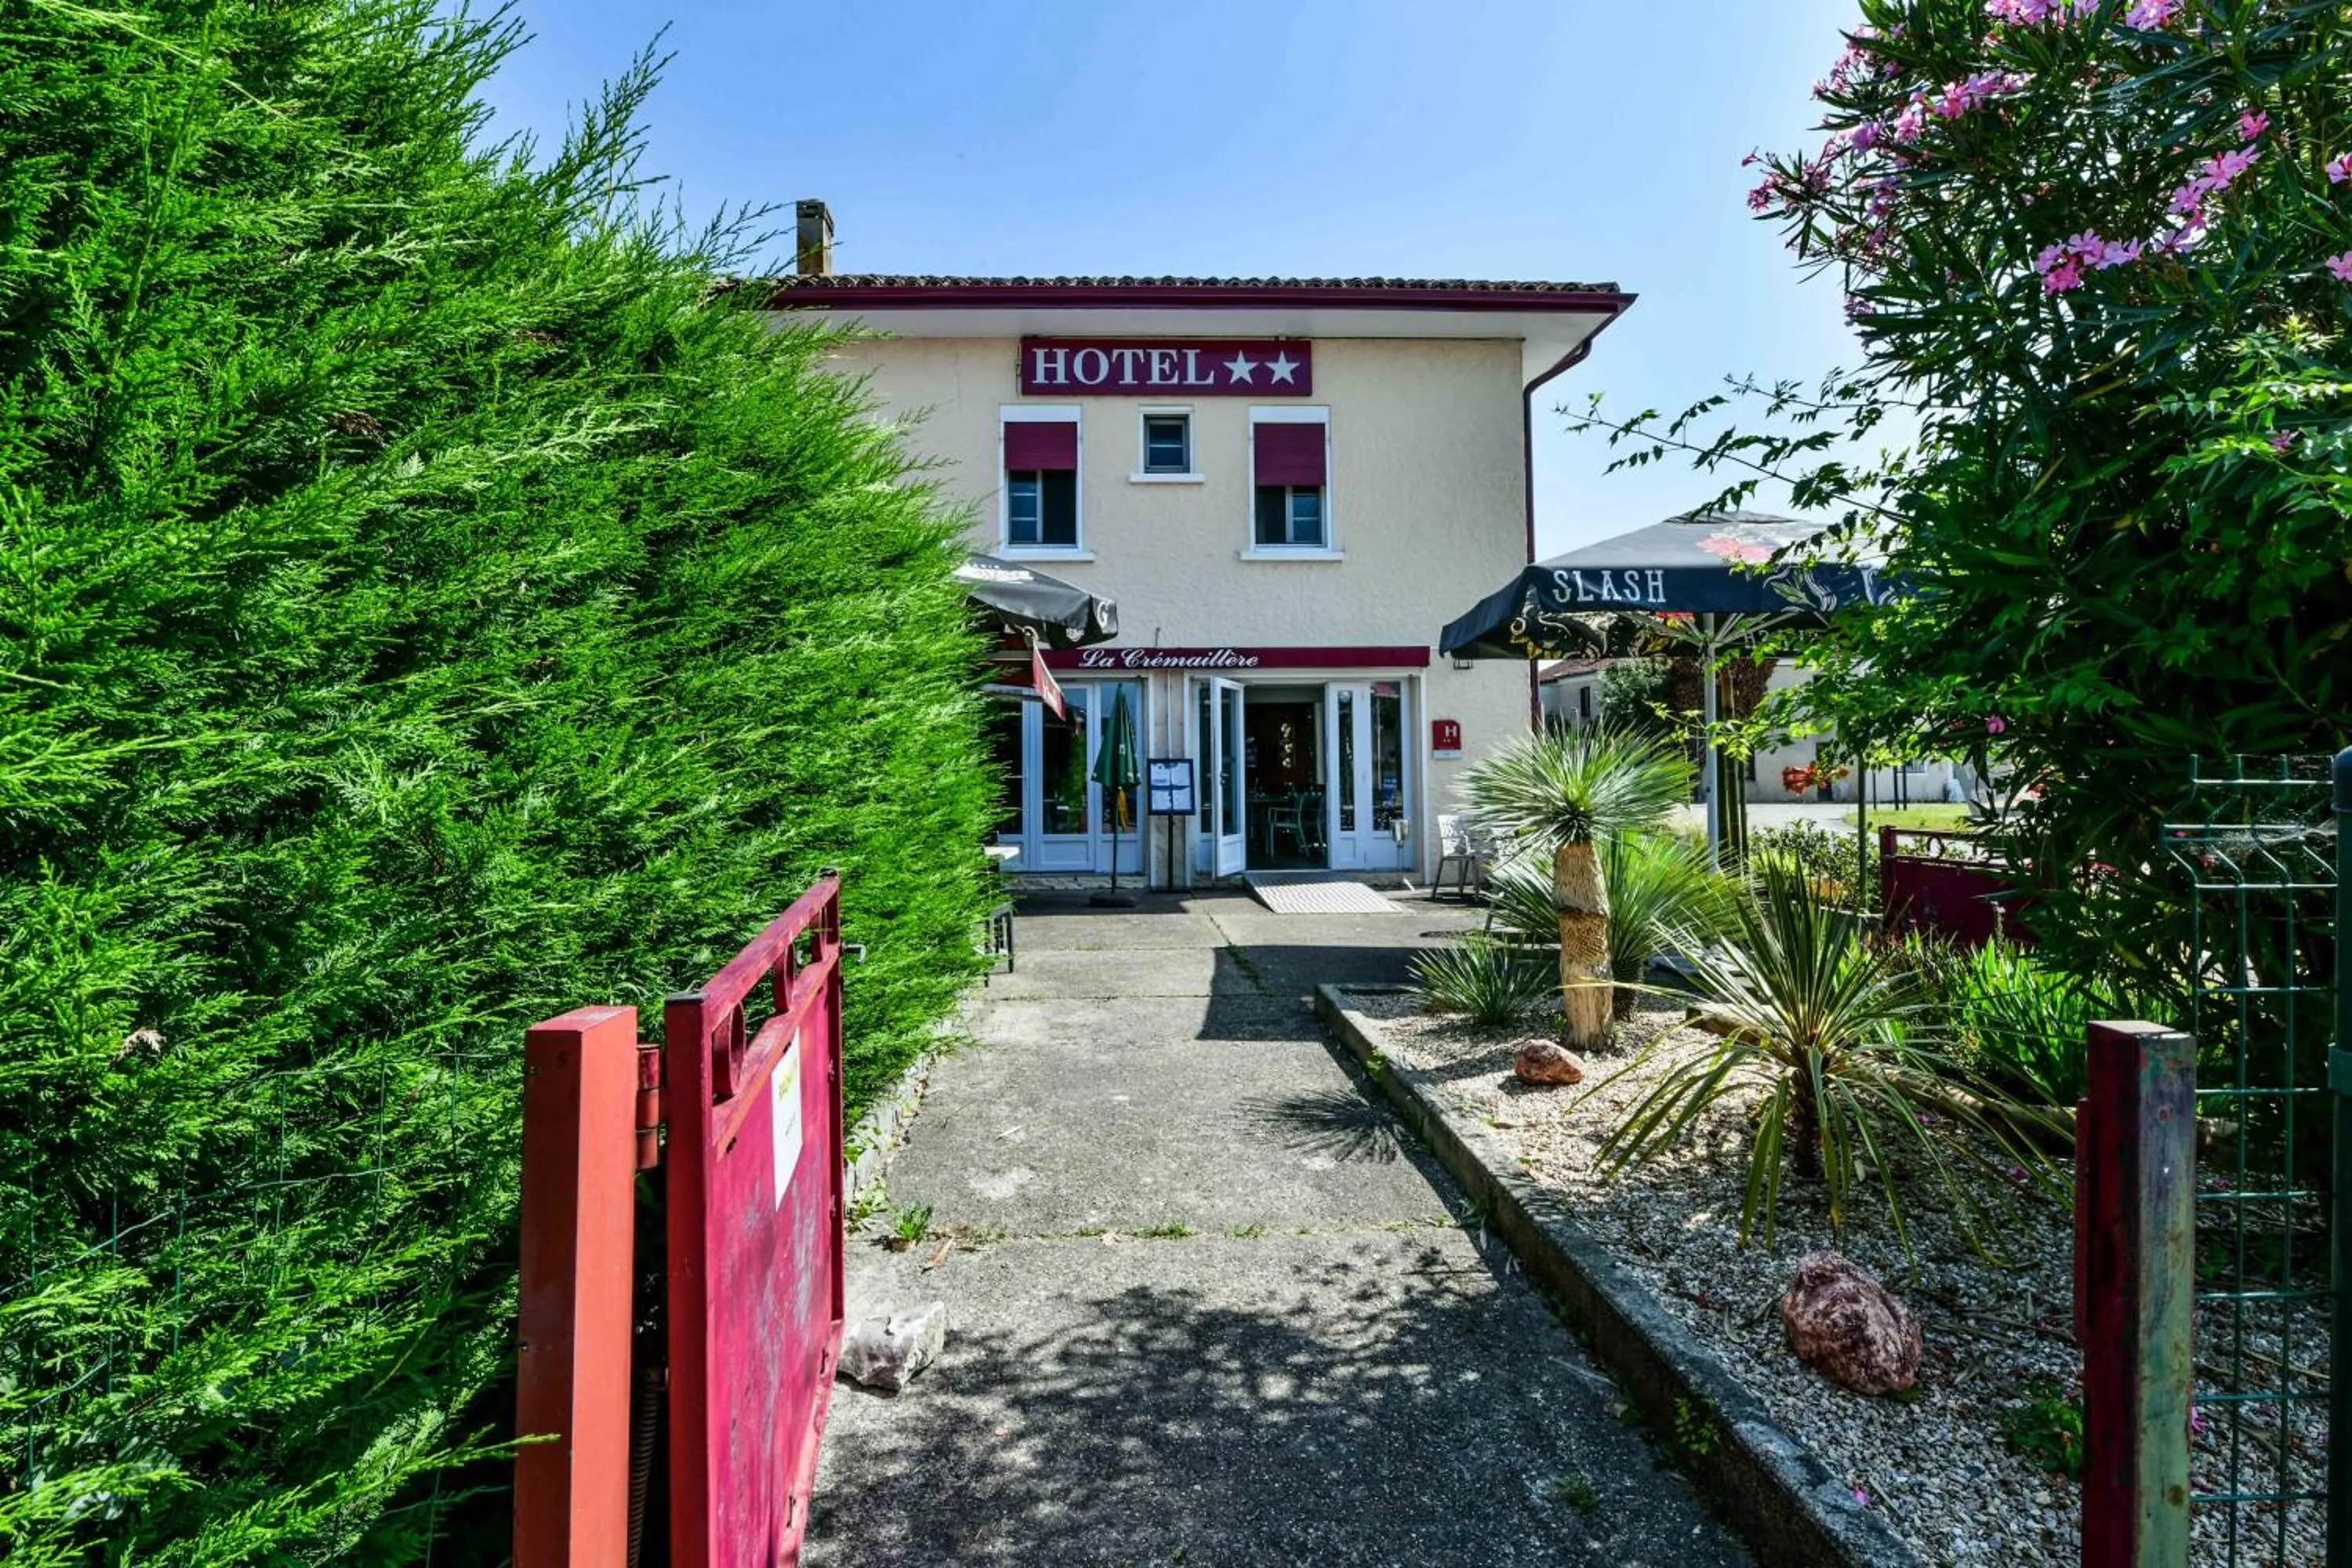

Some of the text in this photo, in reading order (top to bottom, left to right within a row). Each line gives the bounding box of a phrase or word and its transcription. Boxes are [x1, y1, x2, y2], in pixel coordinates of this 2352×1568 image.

[1032, 348, 1214, 385] HOTEL
[1552, 569, 1666, 603] SLASH
[1079, 649, 1260, 669] La Crémaillère
[1445, 725, 1457, 737] H
